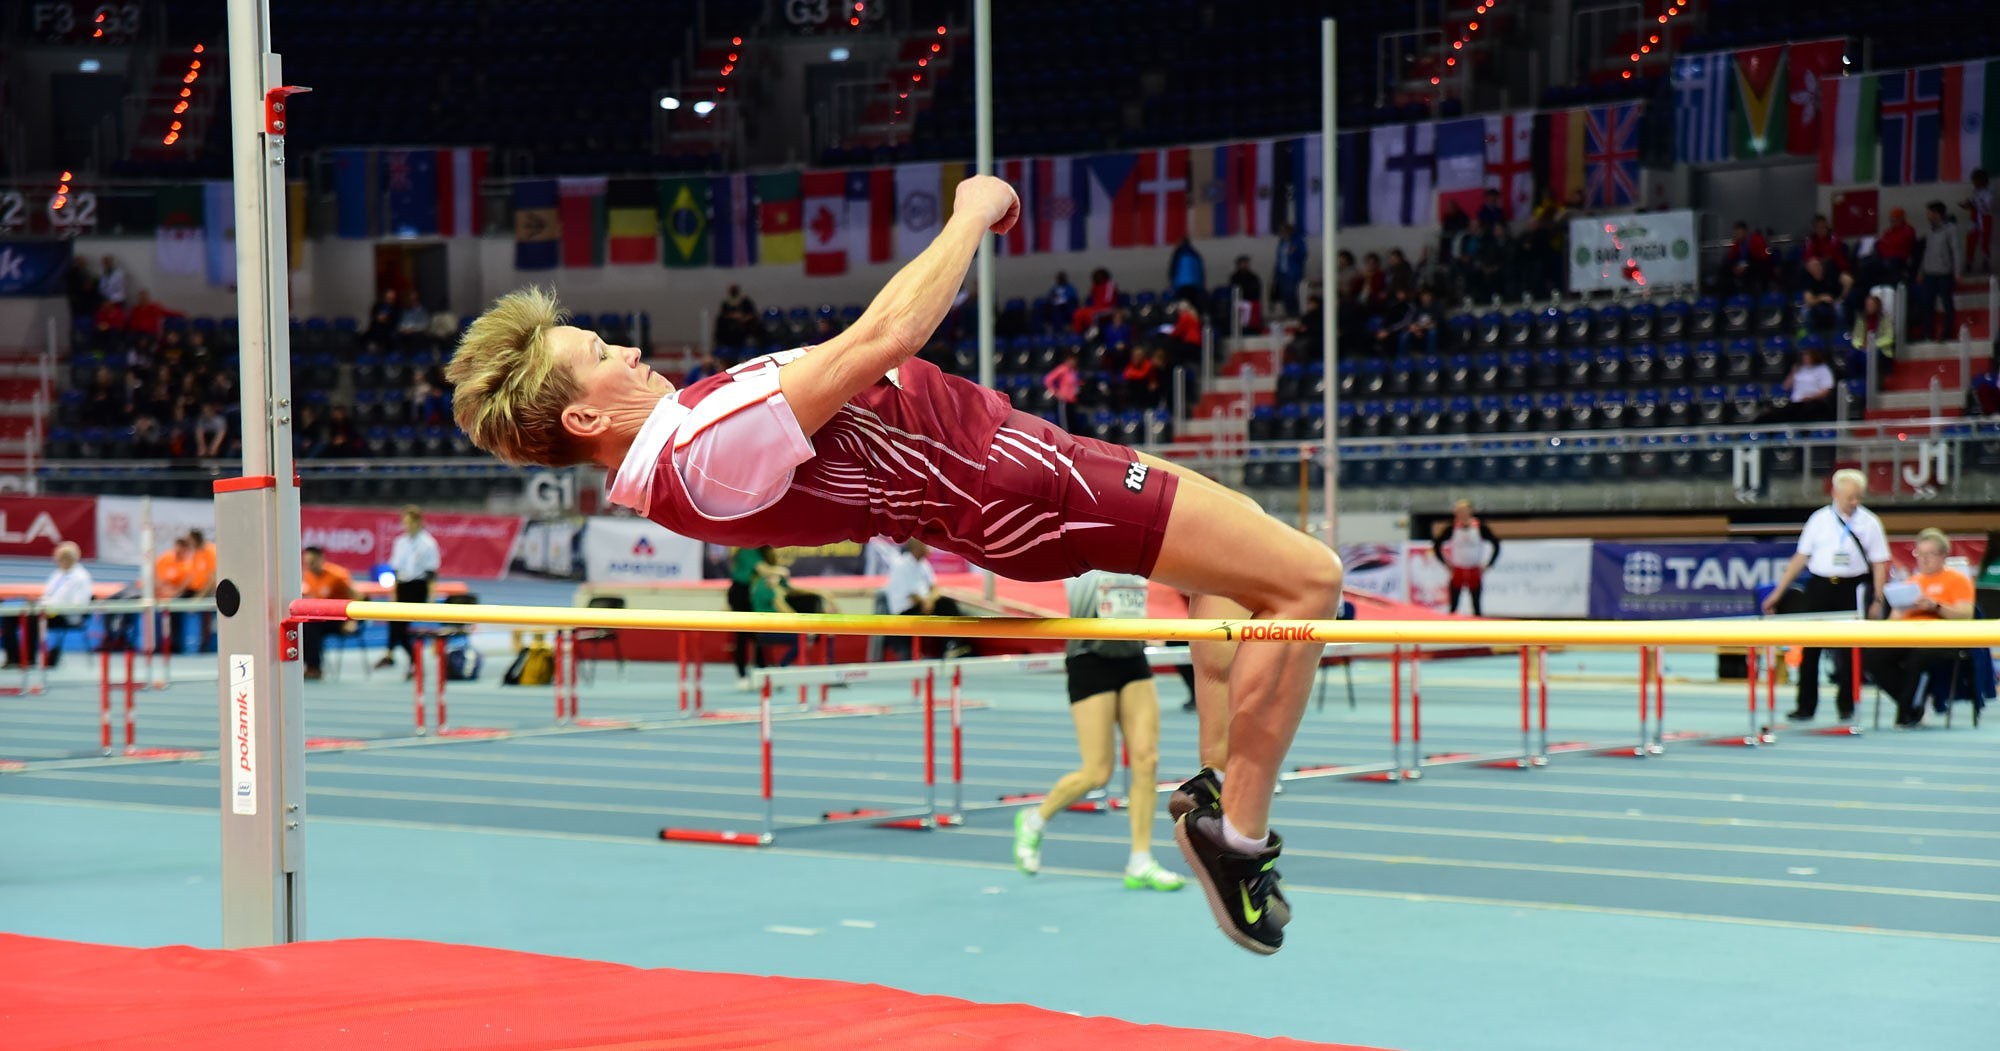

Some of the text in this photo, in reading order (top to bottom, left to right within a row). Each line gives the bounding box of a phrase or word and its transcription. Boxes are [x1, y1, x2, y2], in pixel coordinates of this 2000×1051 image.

[0, 191, 23, 225] 2
[48, 192, 97, 226] G2
[0, 248, 24, 279] k
[527, 472, 575, 510] G1
[1240, 622, 1316, 641] polanik
[237, 692, 251, 772] polanik
